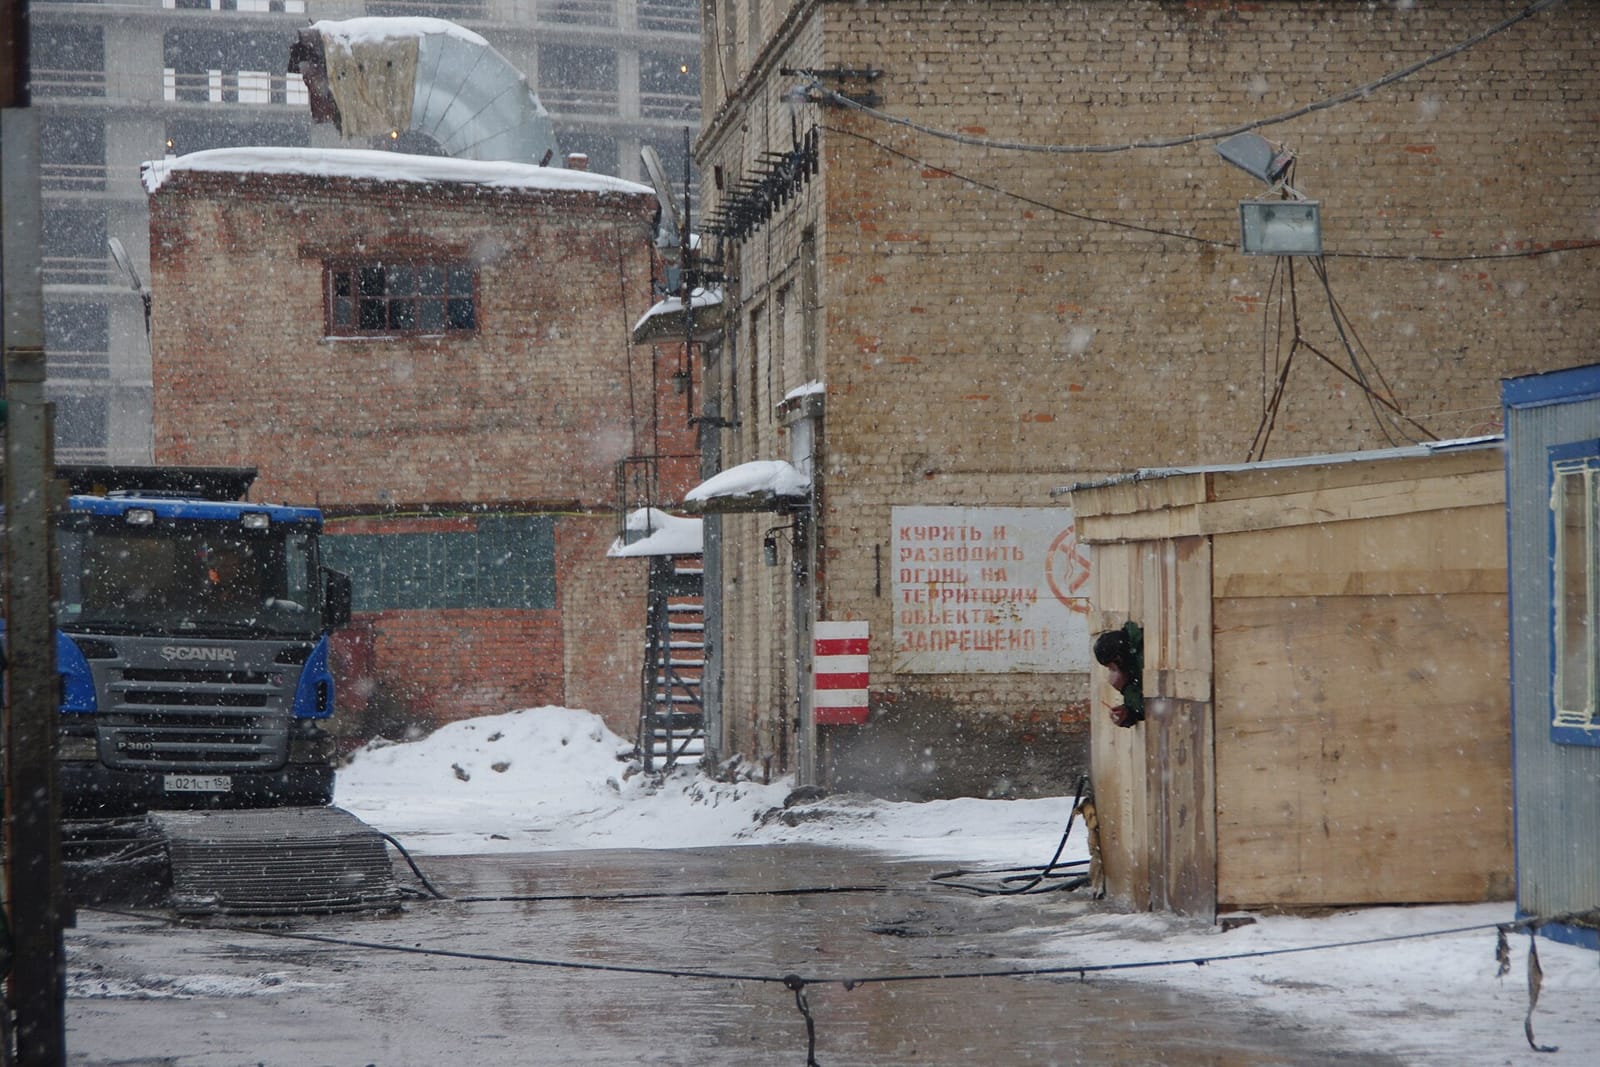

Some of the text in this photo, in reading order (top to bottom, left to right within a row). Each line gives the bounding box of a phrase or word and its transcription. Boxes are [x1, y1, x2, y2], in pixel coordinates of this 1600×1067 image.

[900, 526, 1007, 541] КУРИТЬ И
[900, 547, 1024, 562] РАЗВОДИТЬ
[900, 568, 1007, 583] ОГОНЬ НА
[901, 588, 1037, 604] ТЕРРИТОРИИ
[161, 646, 235, 661] SCANIA
